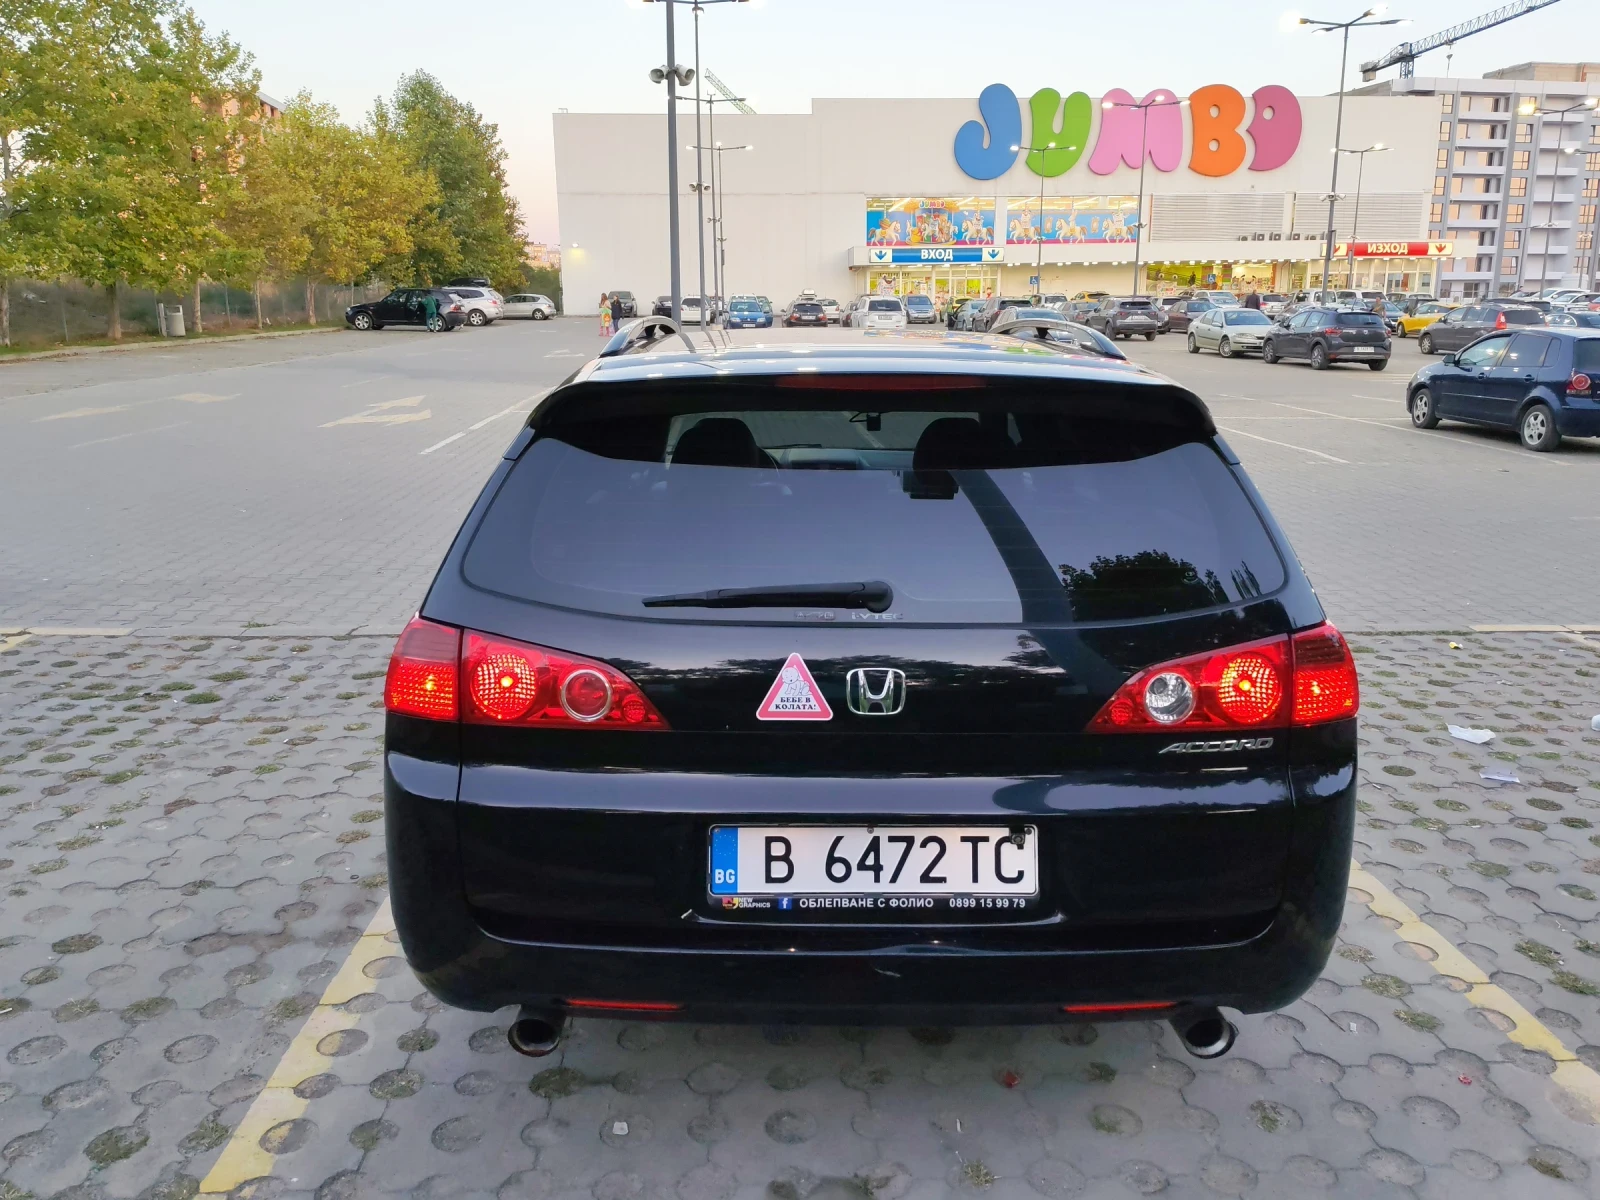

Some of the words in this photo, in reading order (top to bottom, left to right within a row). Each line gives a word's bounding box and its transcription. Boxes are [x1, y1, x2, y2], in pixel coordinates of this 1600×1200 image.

[954, 83, 1302, 180] JUMBO
[919, 200, 946, 208] JUMBO
[921, 249, 953, 261] ВХОД
[1367, 243, 1408, 255] ИЗХОД
[1158, 737, 1274, 754] ACCORD
[764, 836, 795, 883] B
[825, 836, 947, 883] 6472
[960, 836, 1025, 883] TC
[714, 869, 736, 884] BG
[799, 898, 874, 908] ОБЛЕПВАНЕ
[877, 898, 886, 908] С
[889, 897, 934, 908] ФОЛИО
[949, 898, 976, 908] 0899
[980, 898, 993, 908] 15
[995, 898, 1009, 908] 99
[1012, 898, 1026, 908] 79
